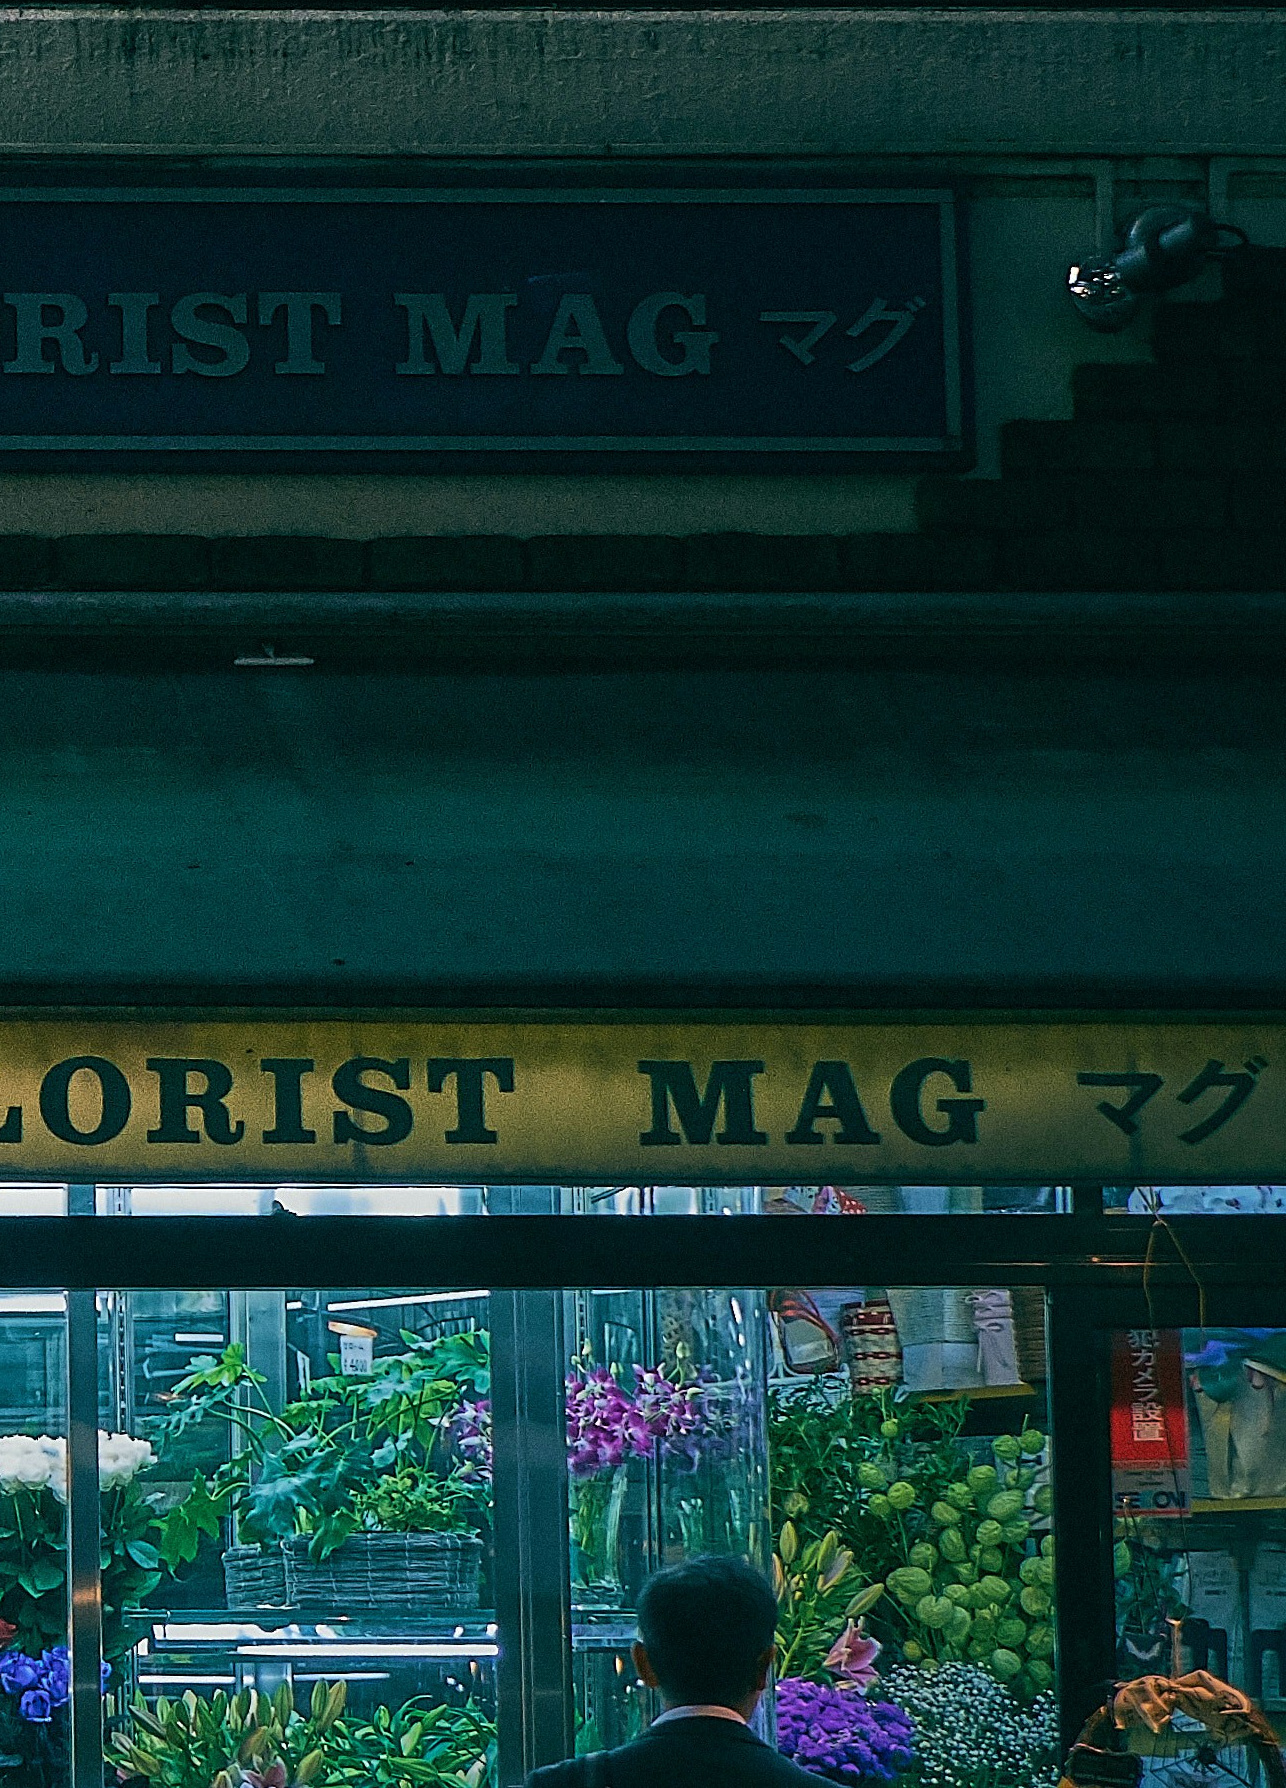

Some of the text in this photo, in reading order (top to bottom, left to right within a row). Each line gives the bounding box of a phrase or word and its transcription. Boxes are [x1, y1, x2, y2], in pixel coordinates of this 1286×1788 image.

[393, 288, 721, 379] MAG
[756, 293, 929, 375] マグ
[637, 1056, 989, 1148] MAG
[1076, 1054, 1271, 1147] マグ
